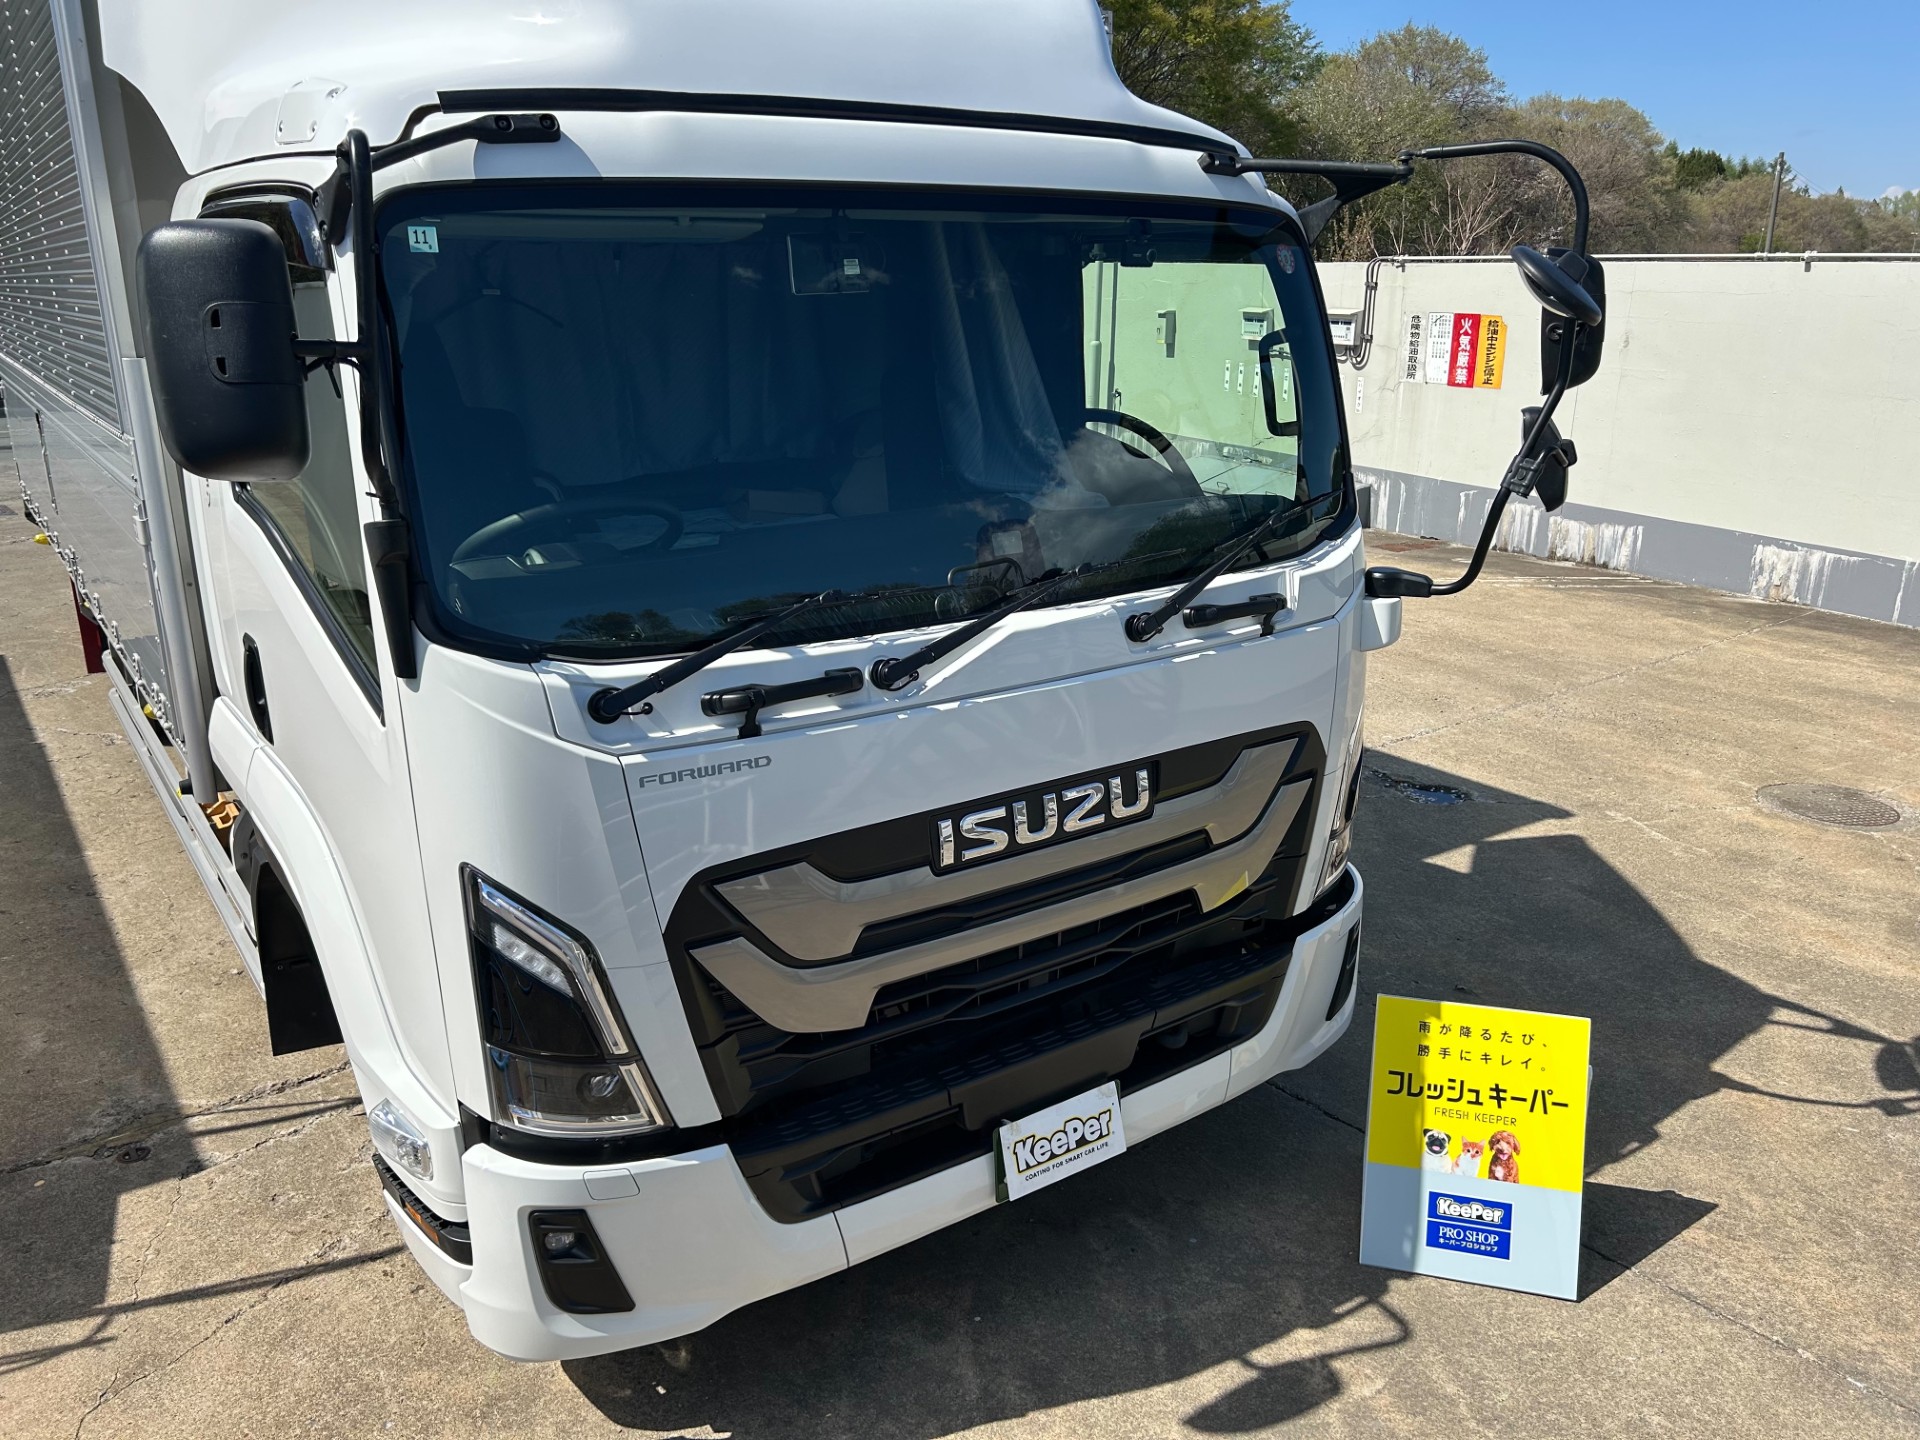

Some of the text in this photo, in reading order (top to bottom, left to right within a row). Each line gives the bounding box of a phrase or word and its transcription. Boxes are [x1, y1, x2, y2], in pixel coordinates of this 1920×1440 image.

[412, 229, 429, 244] 11
[1405, 314, 1421, 380] 危険物給油取扱所
[1455, 317, 1472, 385] 火気厳禁
[1482, 319, 1500, 386] 給油中エンジン停止
[638, 755, 773, 788] FORWARD
[937, 768, 1150, 867] ISUZU
[1418, 1020, 1548, 1048] 雨が降るたび、
[1417, 1043, 1546, 1072] 勝手にキレイ。
[1386, 1069, 1569, 1115] フレッシュキーパー
[1434, 1106, 1517, 1127] FRESH KEEPER
[1013, 1108, 1112, 1174] KeePer
[1025, 1141, 1109, 1182] COATING FOR SMART CAR LIFE
[1437, 1197, 1504, 1224] KeePer
[1438, 1238, 1498, 1252] キーパープロショップ
[1439, 1226, 1499, 1245] PRO SHOP
